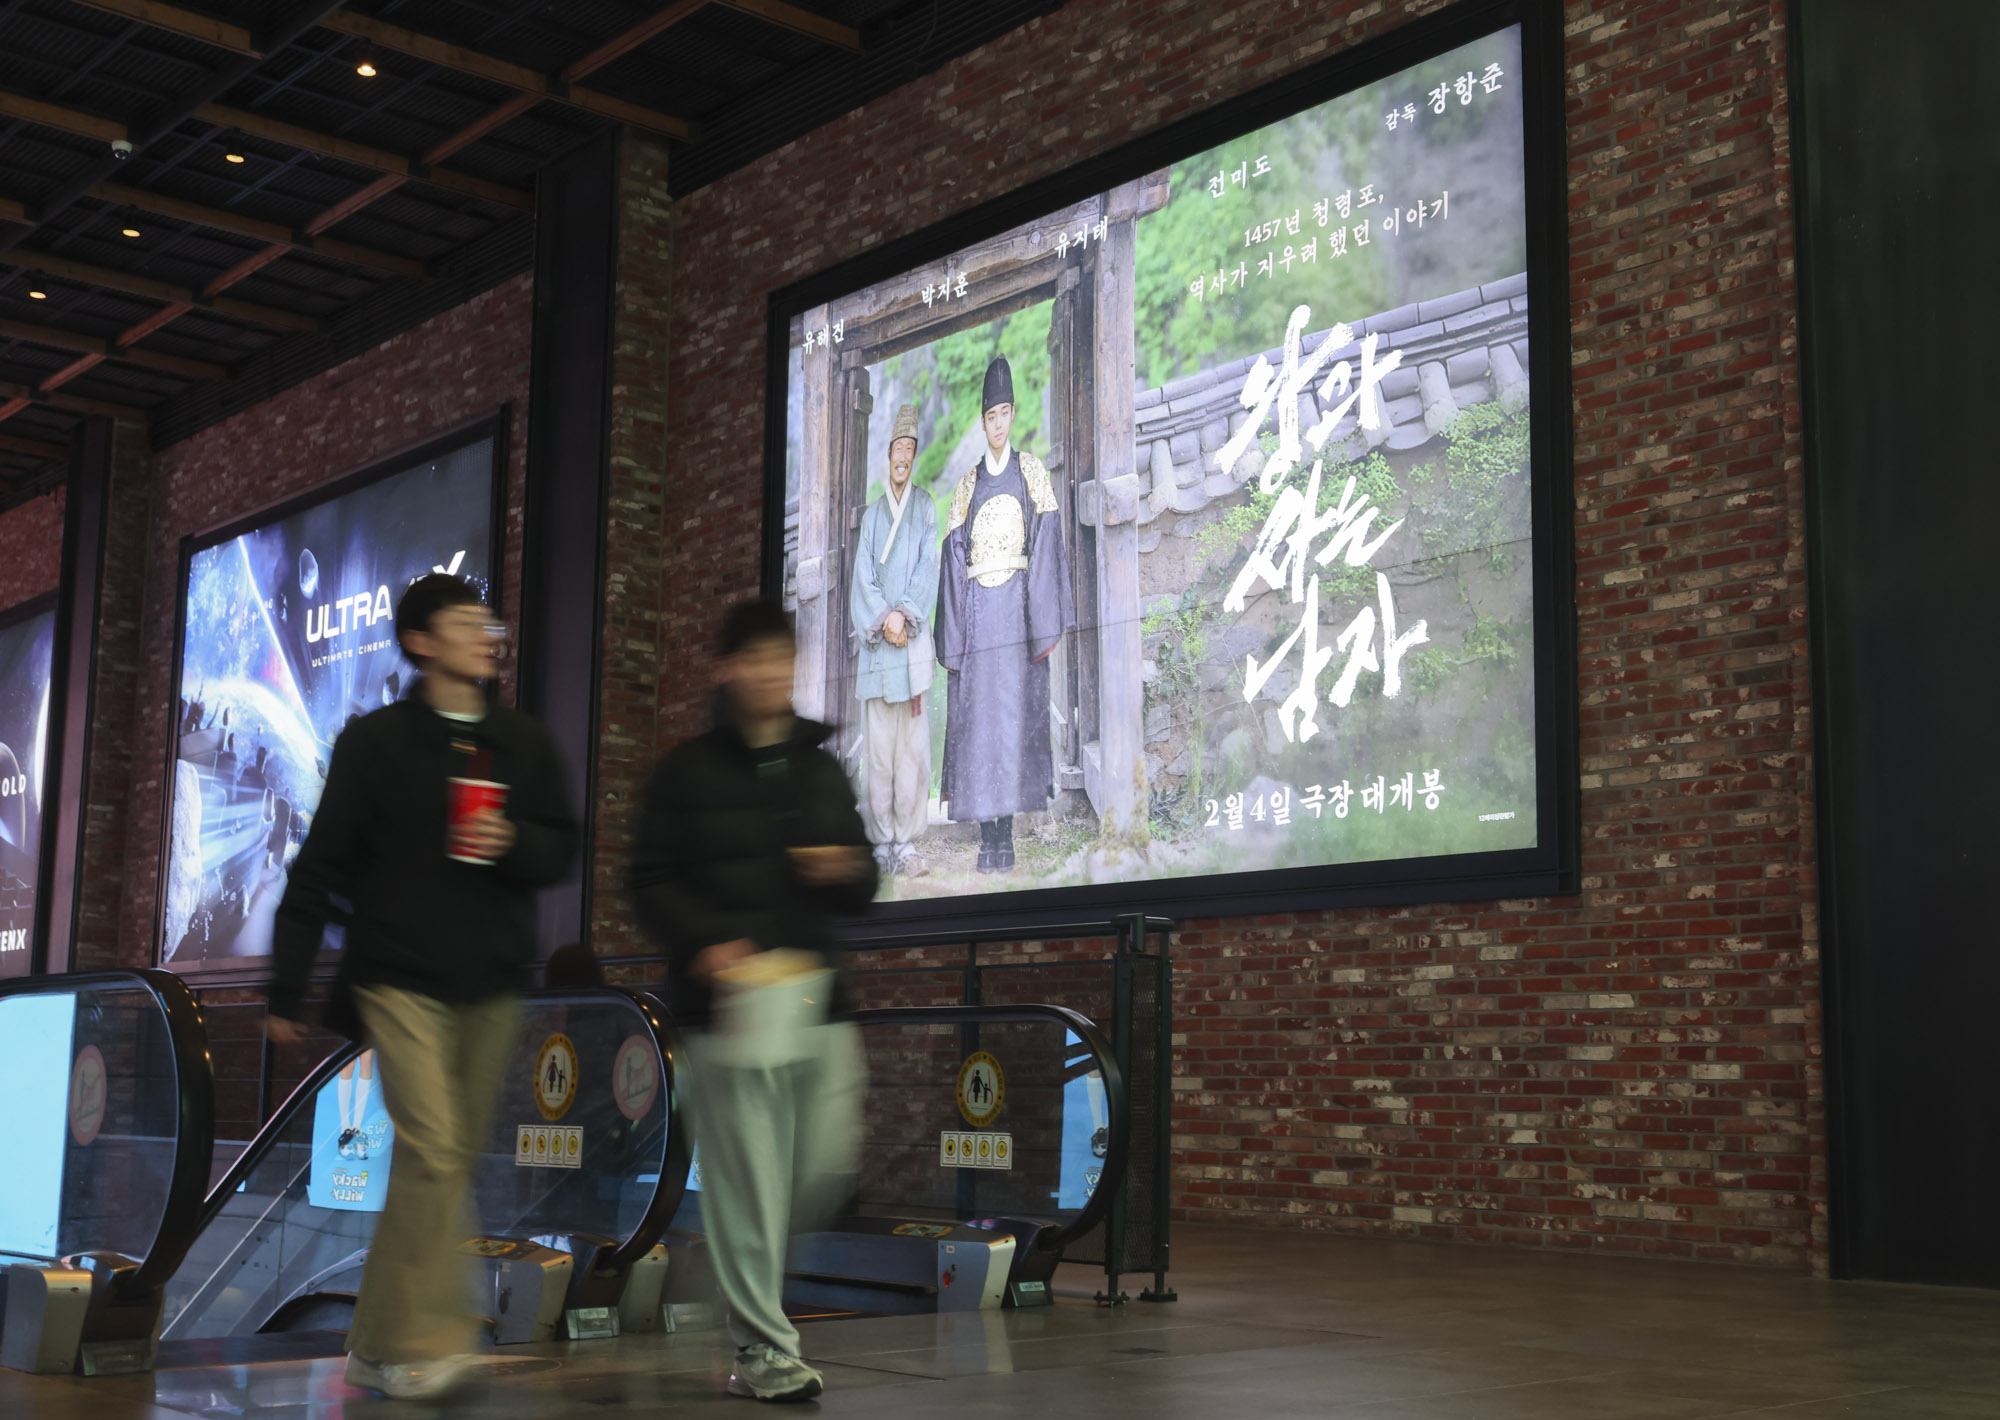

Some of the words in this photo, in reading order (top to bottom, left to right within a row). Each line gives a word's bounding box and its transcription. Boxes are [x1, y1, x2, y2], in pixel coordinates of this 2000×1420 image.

[1384, 102, 1417, 132] 감독
[1427, 61, 1505, 115] 장항준
[1207, 154, 1272, 198] 전미도
[1054, 216, 1108, 259] 유지태
[1244, 209, 1300, 248] 1457년
[1311, 183, 1385, 228] 청령포,
[1189, 261, 1248, 302] 역사가
[1256, 236, 1317, 278] 지우려
[1328, 219, 1370, 259] 했던
[1382, 190, 1449, 236] 이야기
[921, 271, 969, 308] 박지훈
[802, 318, 845, 355] 유해진
[1214, 305, 1404, 494] 왕과
[1223, 459, 1405, 613] 사는
[306, 584, 393, 643] ULTRA
[311, 650, 353, 668] ULTIMATE
[358, 639, 391, 655] CINEMA
[1243, 572, 1430, 743] 남자
[0, 774, 26, 797] OLD
[1204, 792, 1244, 830] 2월
[1249, 786, 1291, 825] 4일
[1299, 779, 1354, 819] 극장
[1360, 768, 1446, 815] 대개봉
[0, 928, 27, 952] ENX
